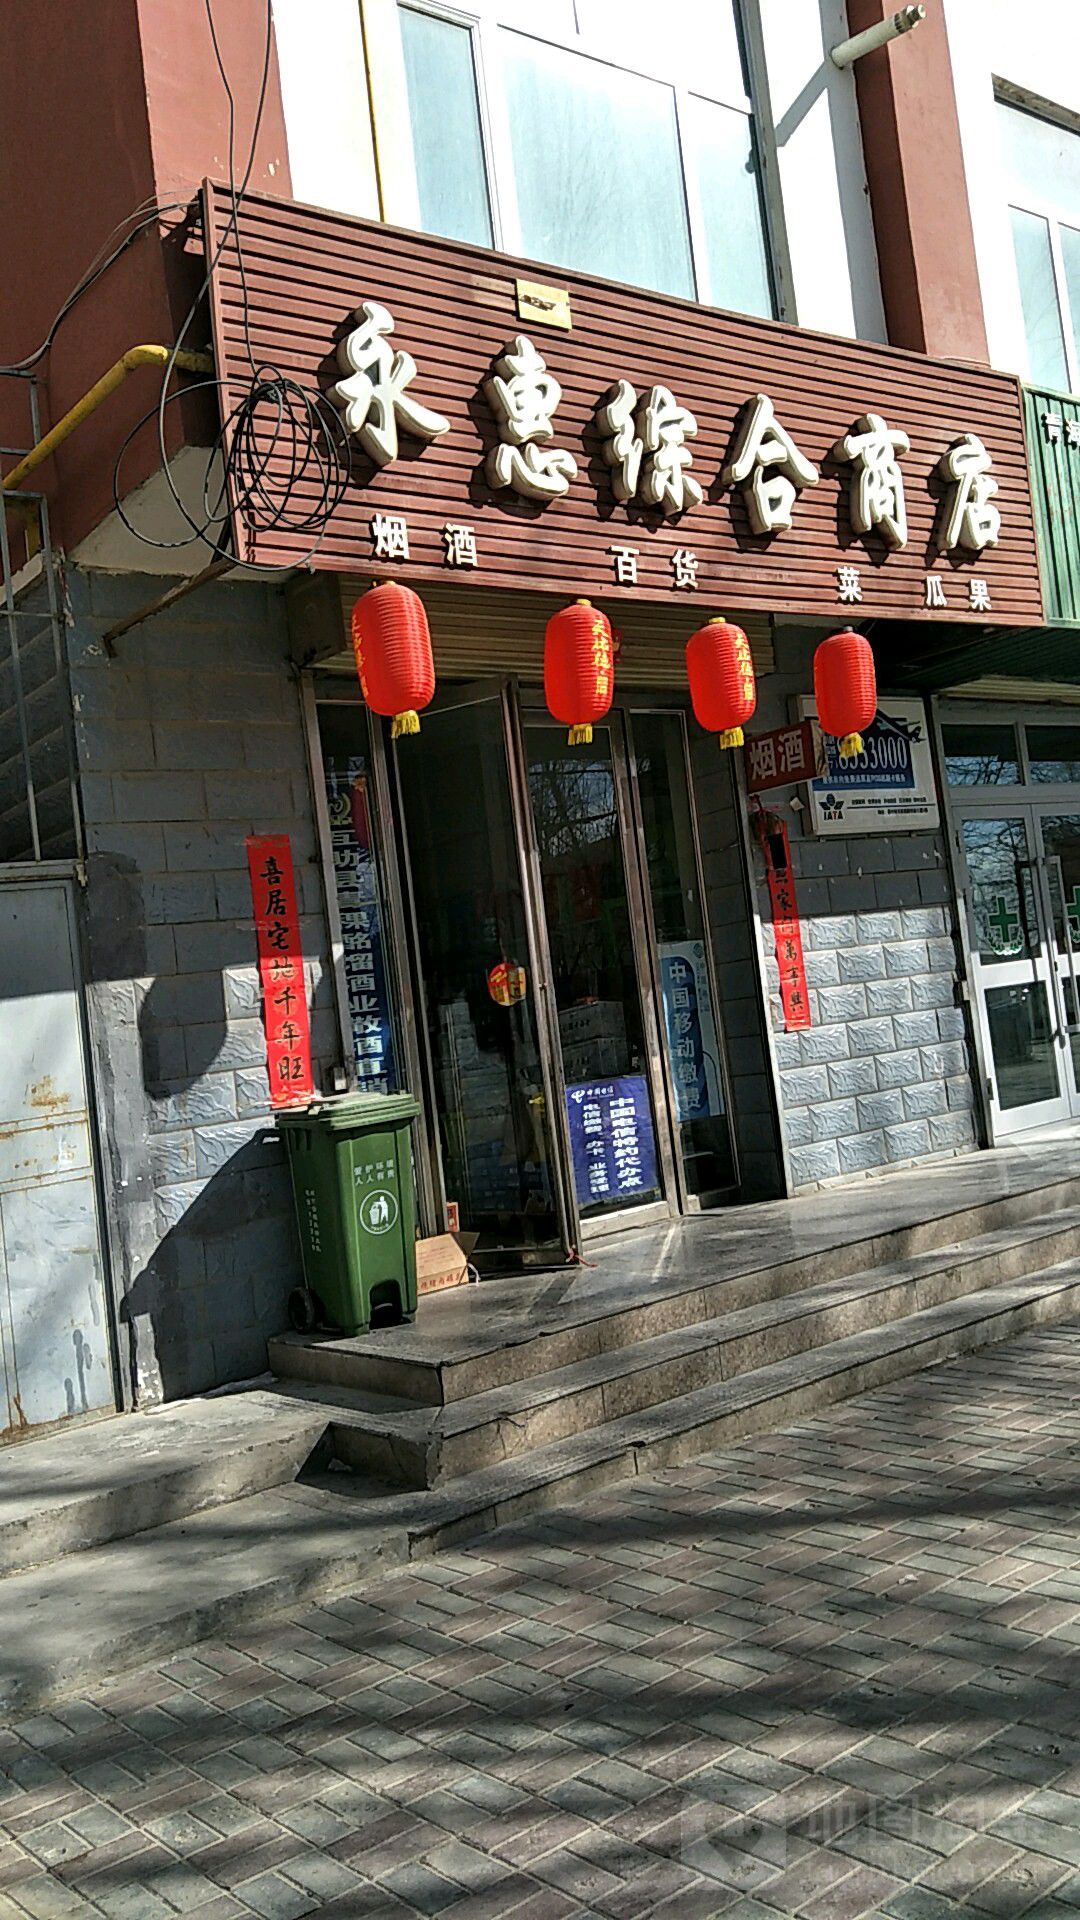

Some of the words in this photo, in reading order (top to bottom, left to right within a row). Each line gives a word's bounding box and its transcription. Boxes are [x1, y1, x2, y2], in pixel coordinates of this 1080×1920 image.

[329, 301, 1001, 551] 永惠综合商店
[372, 513, 478, 567] 烟酒
[610, 545, 699, 590] 百货
[837, 566, 863, 602] 菜
[925, 575, 993, 611] 瓜果
[750, 730, 806, 780] 烟酒
[823, 810, 844, 821] IATA
[668, 961, 701, 1110] 中国移动缴费
